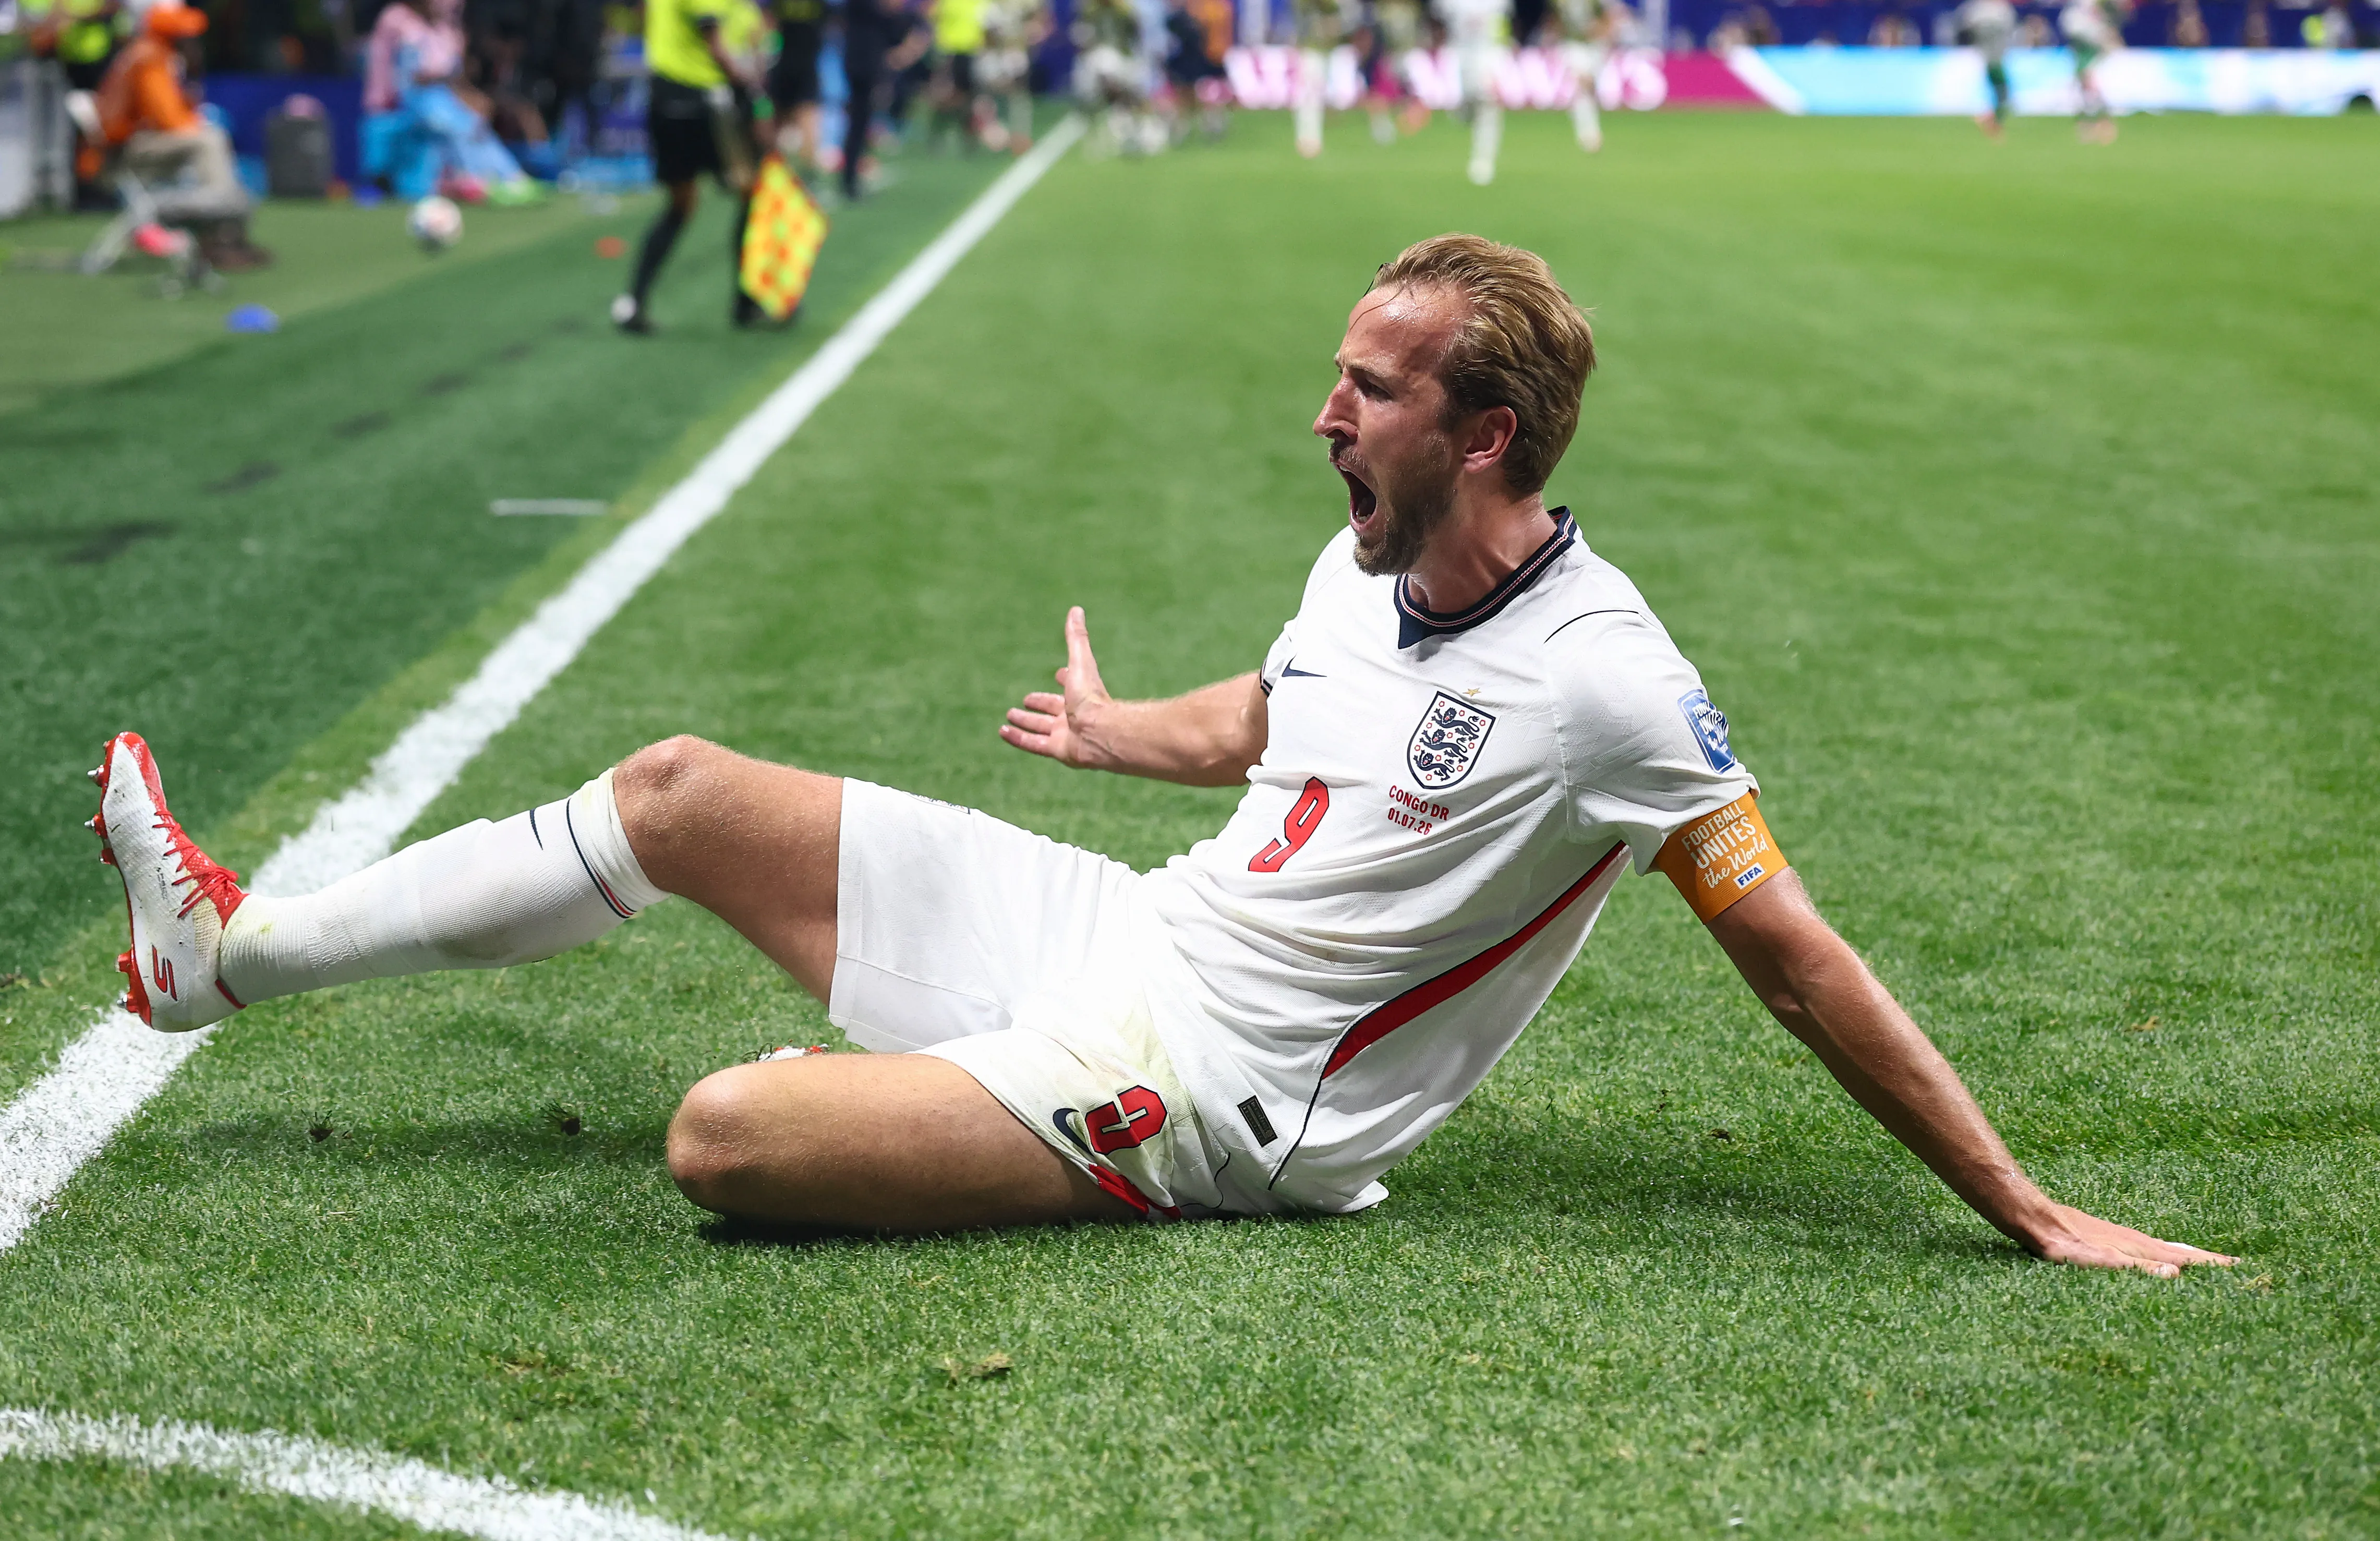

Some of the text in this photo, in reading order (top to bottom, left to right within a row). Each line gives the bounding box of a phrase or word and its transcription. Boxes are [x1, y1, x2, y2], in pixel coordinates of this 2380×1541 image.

[1248, 776, 1330, 873] 9
[1387, 808, 1433, 835] 01.07.26
[1389, 785, 1449, 821] CONGO DR
[1681, 801, 1746, 851] FOOTBALL
[1690, 815, 1757, 869] UNITES
[1702, 833, 1770, 889] the World
[1737, 866, 1762, 886] FIFA
[1084, 1084, 1168, 1156] 9
